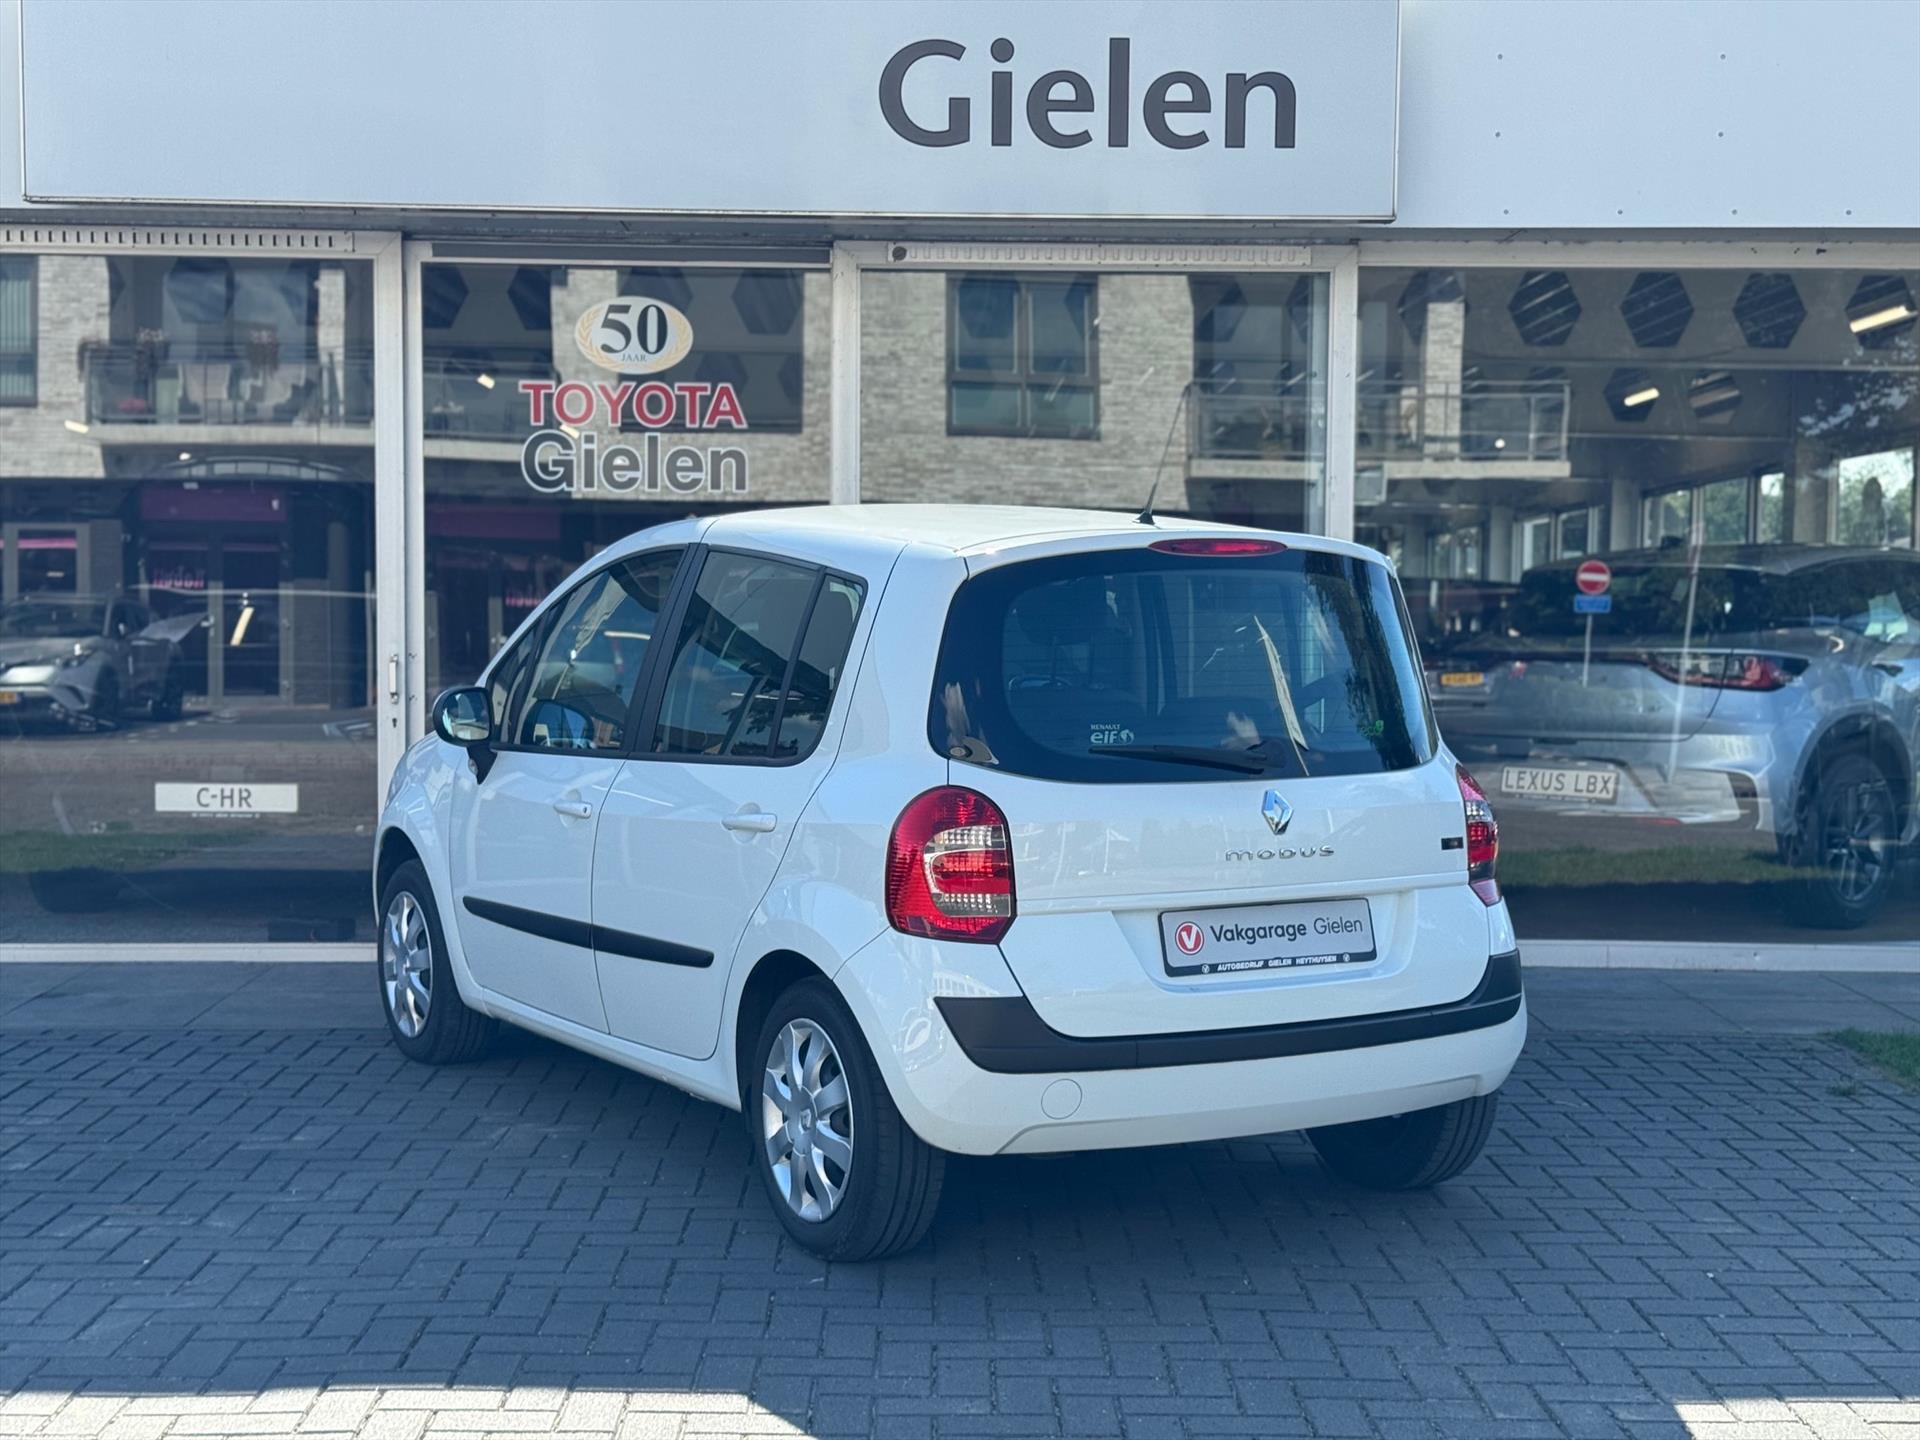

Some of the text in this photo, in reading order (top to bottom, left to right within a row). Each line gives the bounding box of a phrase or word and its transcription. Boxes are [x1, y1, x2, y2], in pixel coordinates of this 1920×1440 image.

[879, 37, 1296, 149] Gielen
[600, 304, 668, 355] 50
[622, 353, 647, 362] JAAR
[519, 380, 748, 428] TOYOTA
[521, 429, 749, 493] Gielen
[1504, 769, 1612, 795] LEXUS LBX
[196, 787, 253, 808] C-HR
[1209, 923, 1307, 945] Vakgarage
[1313, 916, 1363, 935] Gielen
[1217, 960, 1264, 972] AUTOBEDRIJF
[1268, 957, 1292, 967] GIELEN
